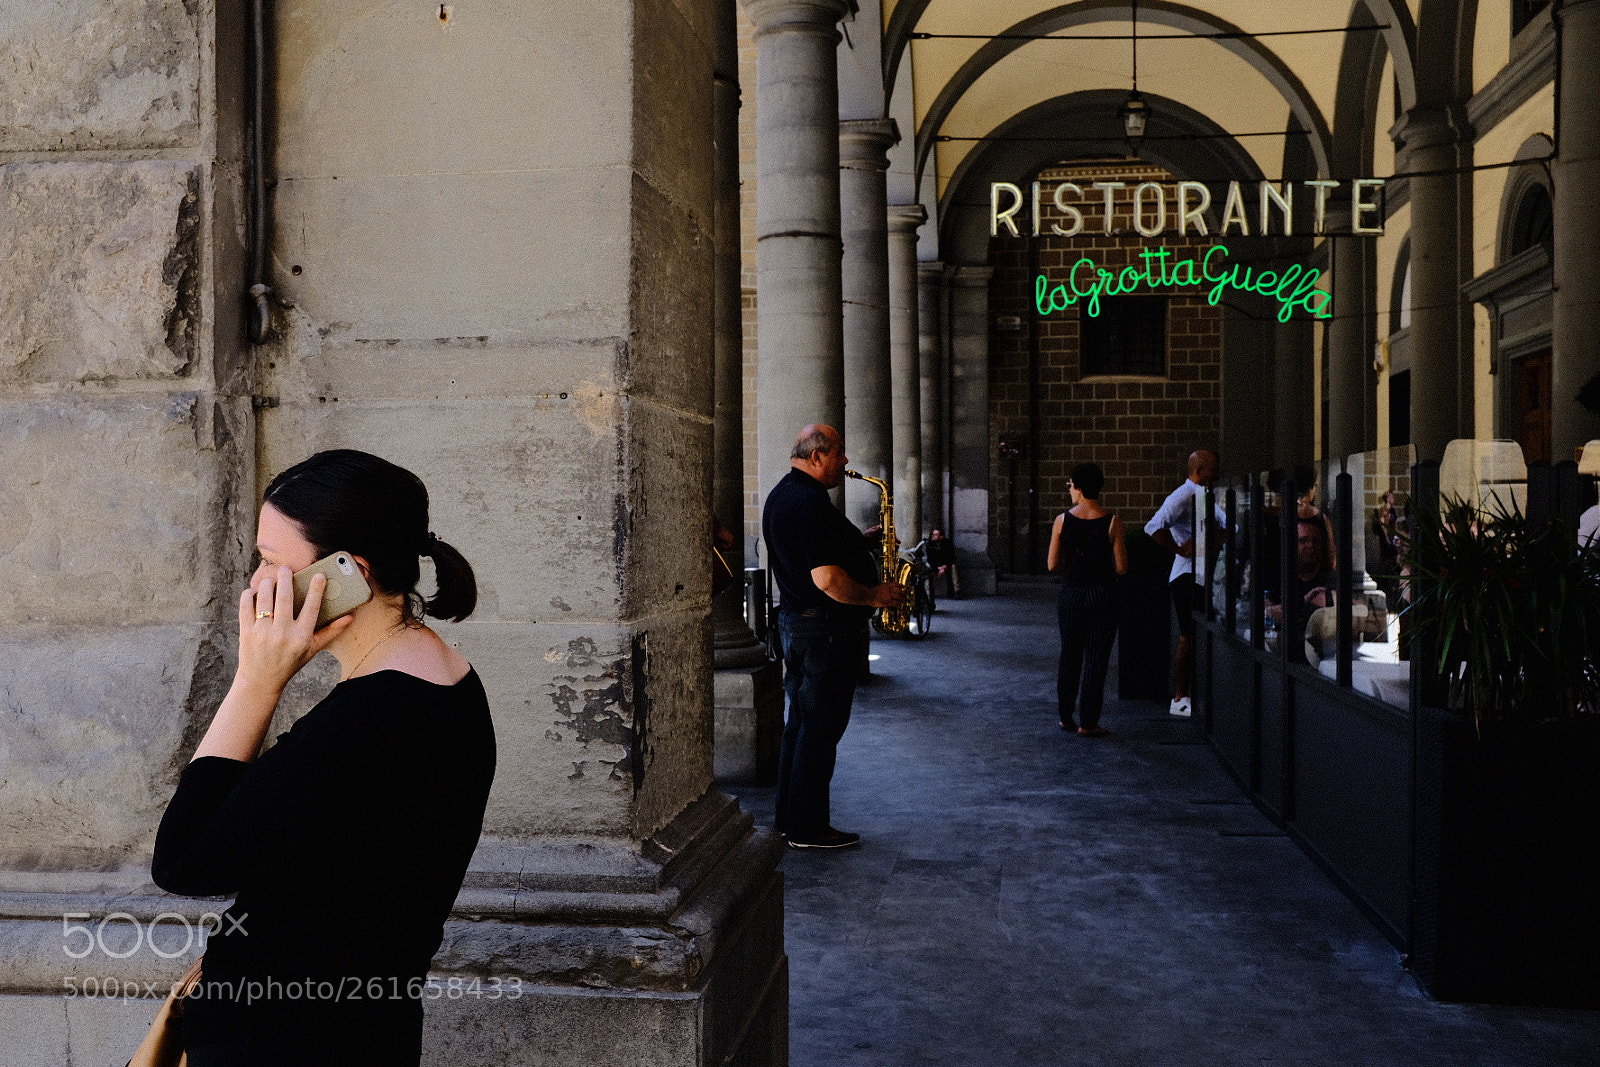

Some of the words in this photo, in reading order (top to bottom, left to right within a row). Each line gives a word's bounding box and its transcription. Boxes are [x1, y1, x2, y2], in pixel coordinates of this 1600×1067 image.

[990, 180, 1385, 238] RISTORANTE
[1069, 245, 1203, 318] Grotta
[1202, 244, 1334, 323] Guelfa
